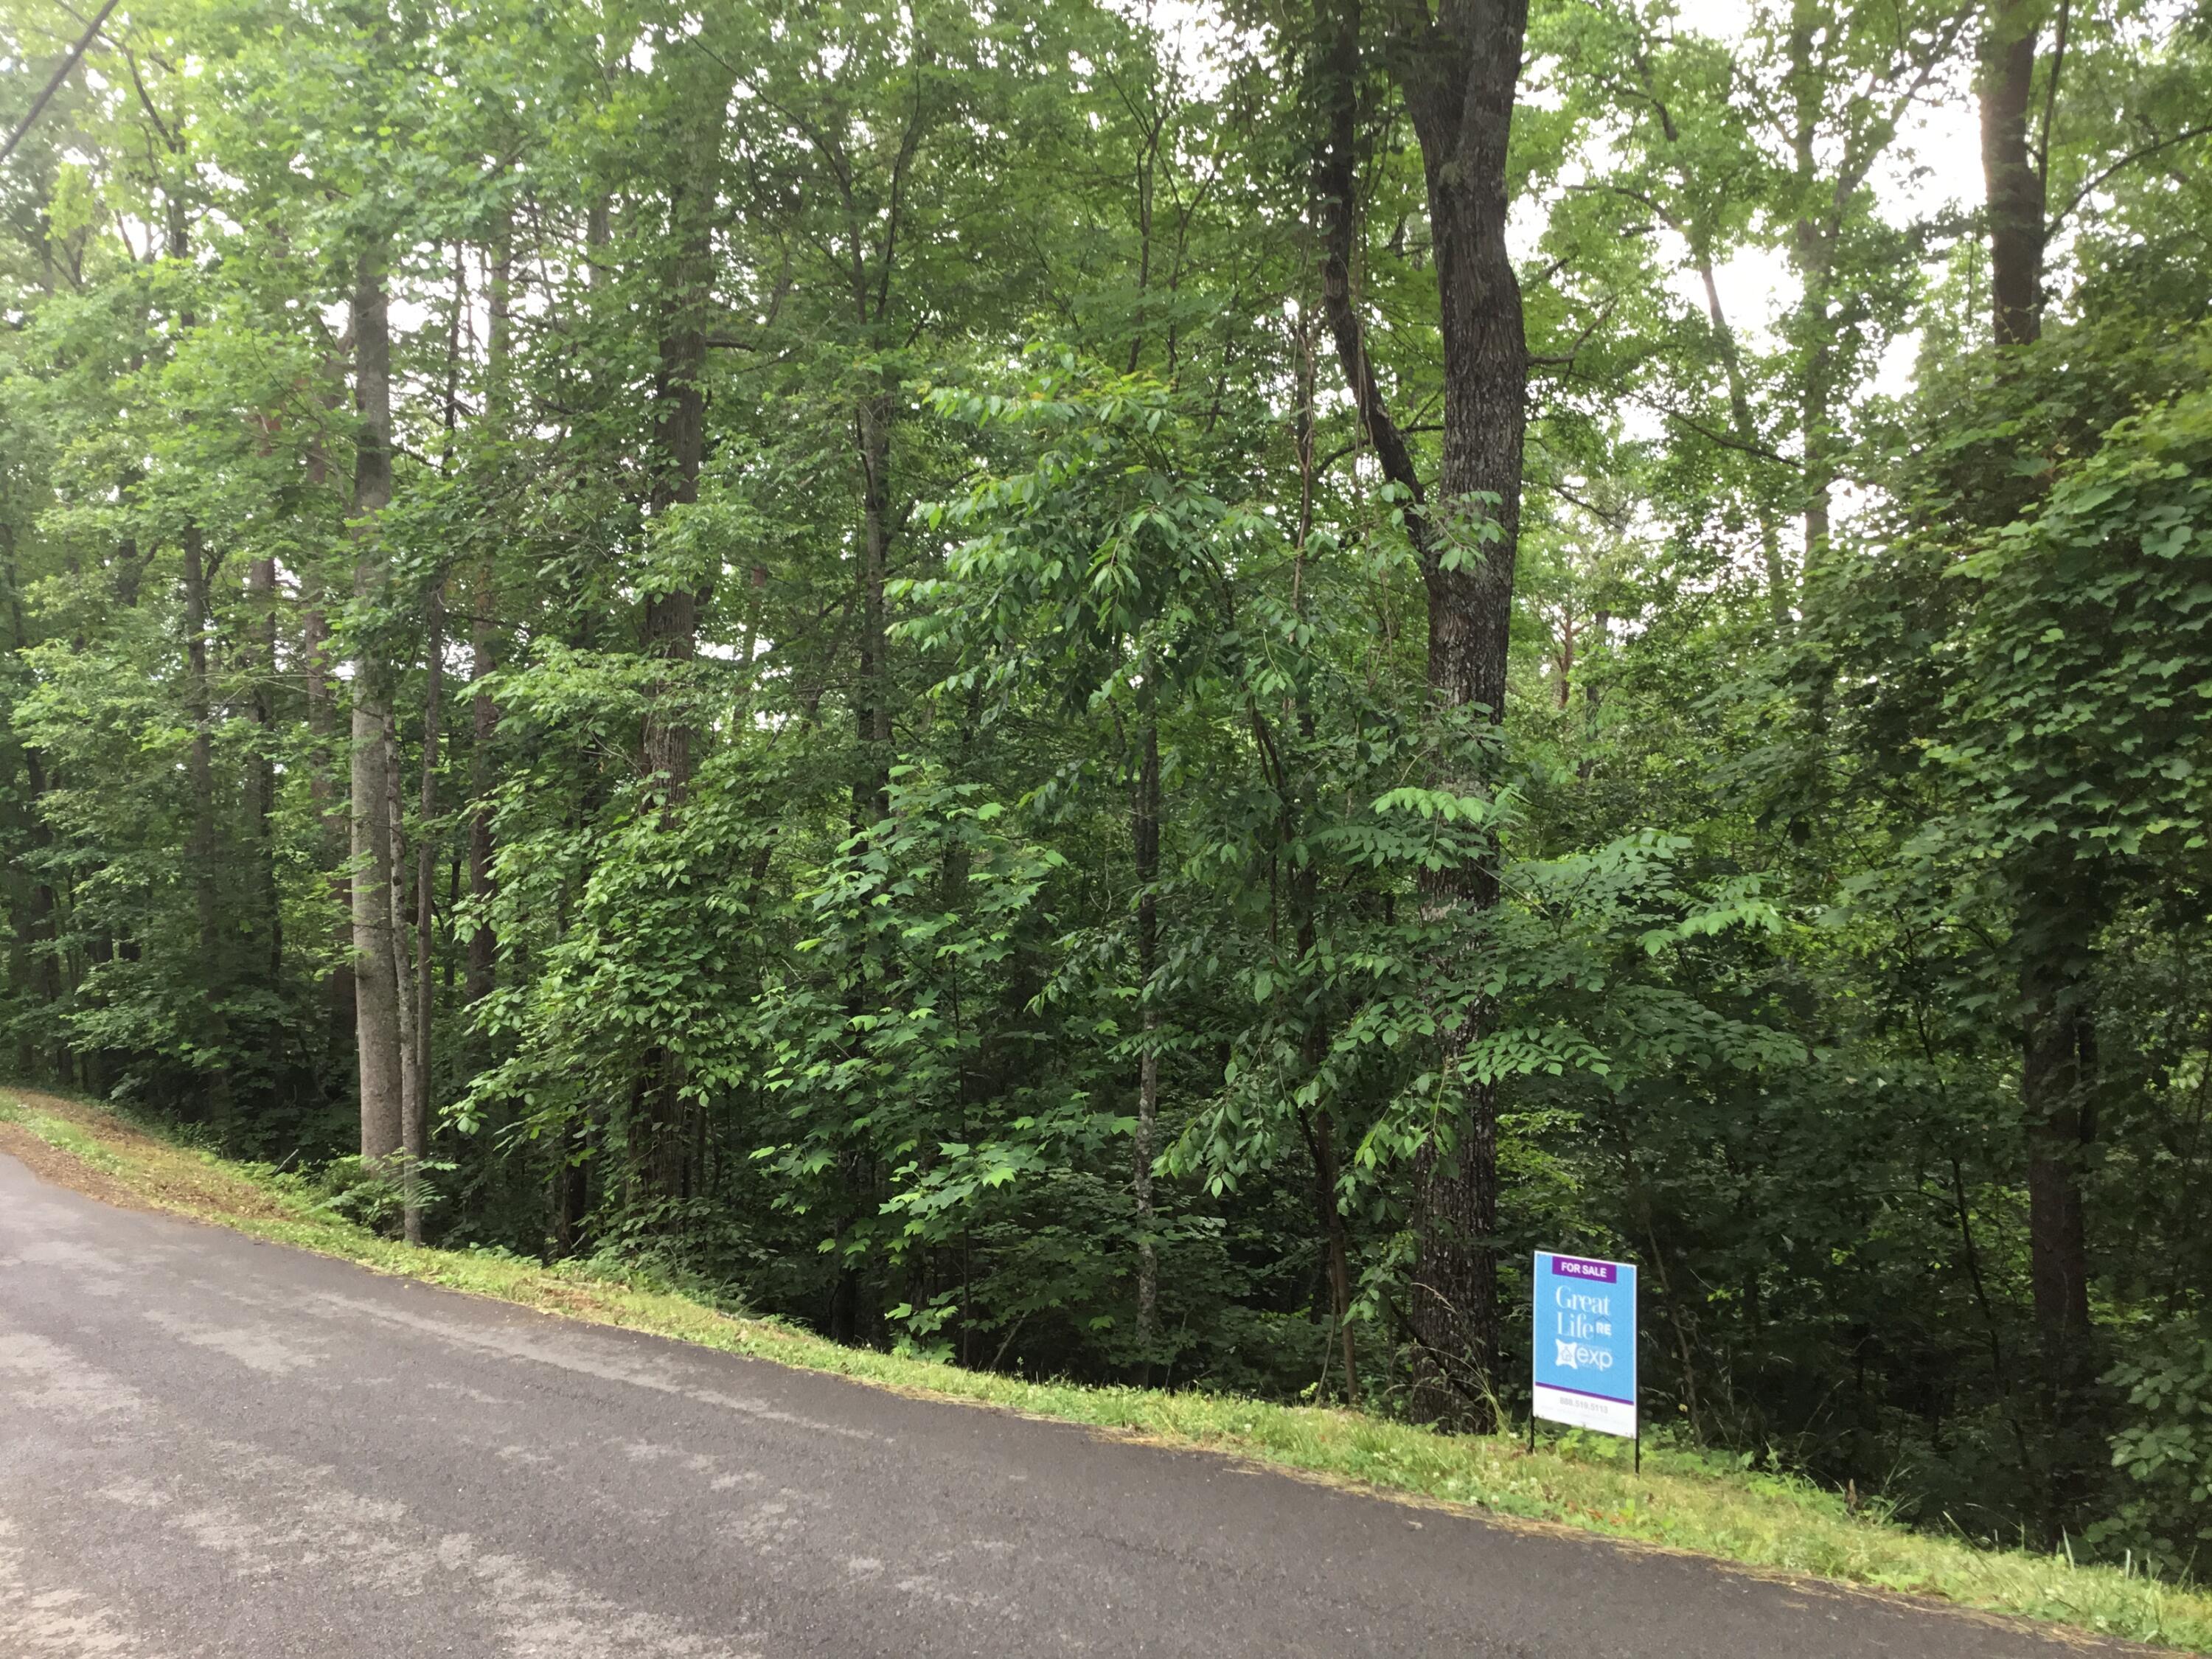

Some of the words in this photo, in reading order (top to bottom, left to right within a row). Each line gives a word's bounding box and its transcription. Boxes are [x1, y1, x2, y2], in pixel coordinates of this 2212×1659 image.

[1561, 1262, 1582, 1275] FOR
[1582, 1264, 1607, 1278] SALE
[1556, 1285, 1610, 1316] Great
[1557, 1312, 1593, 1340] Life
[1596, 1322, 1612, 1336] RE
[1576, 1347, 1613, 1371] exp
